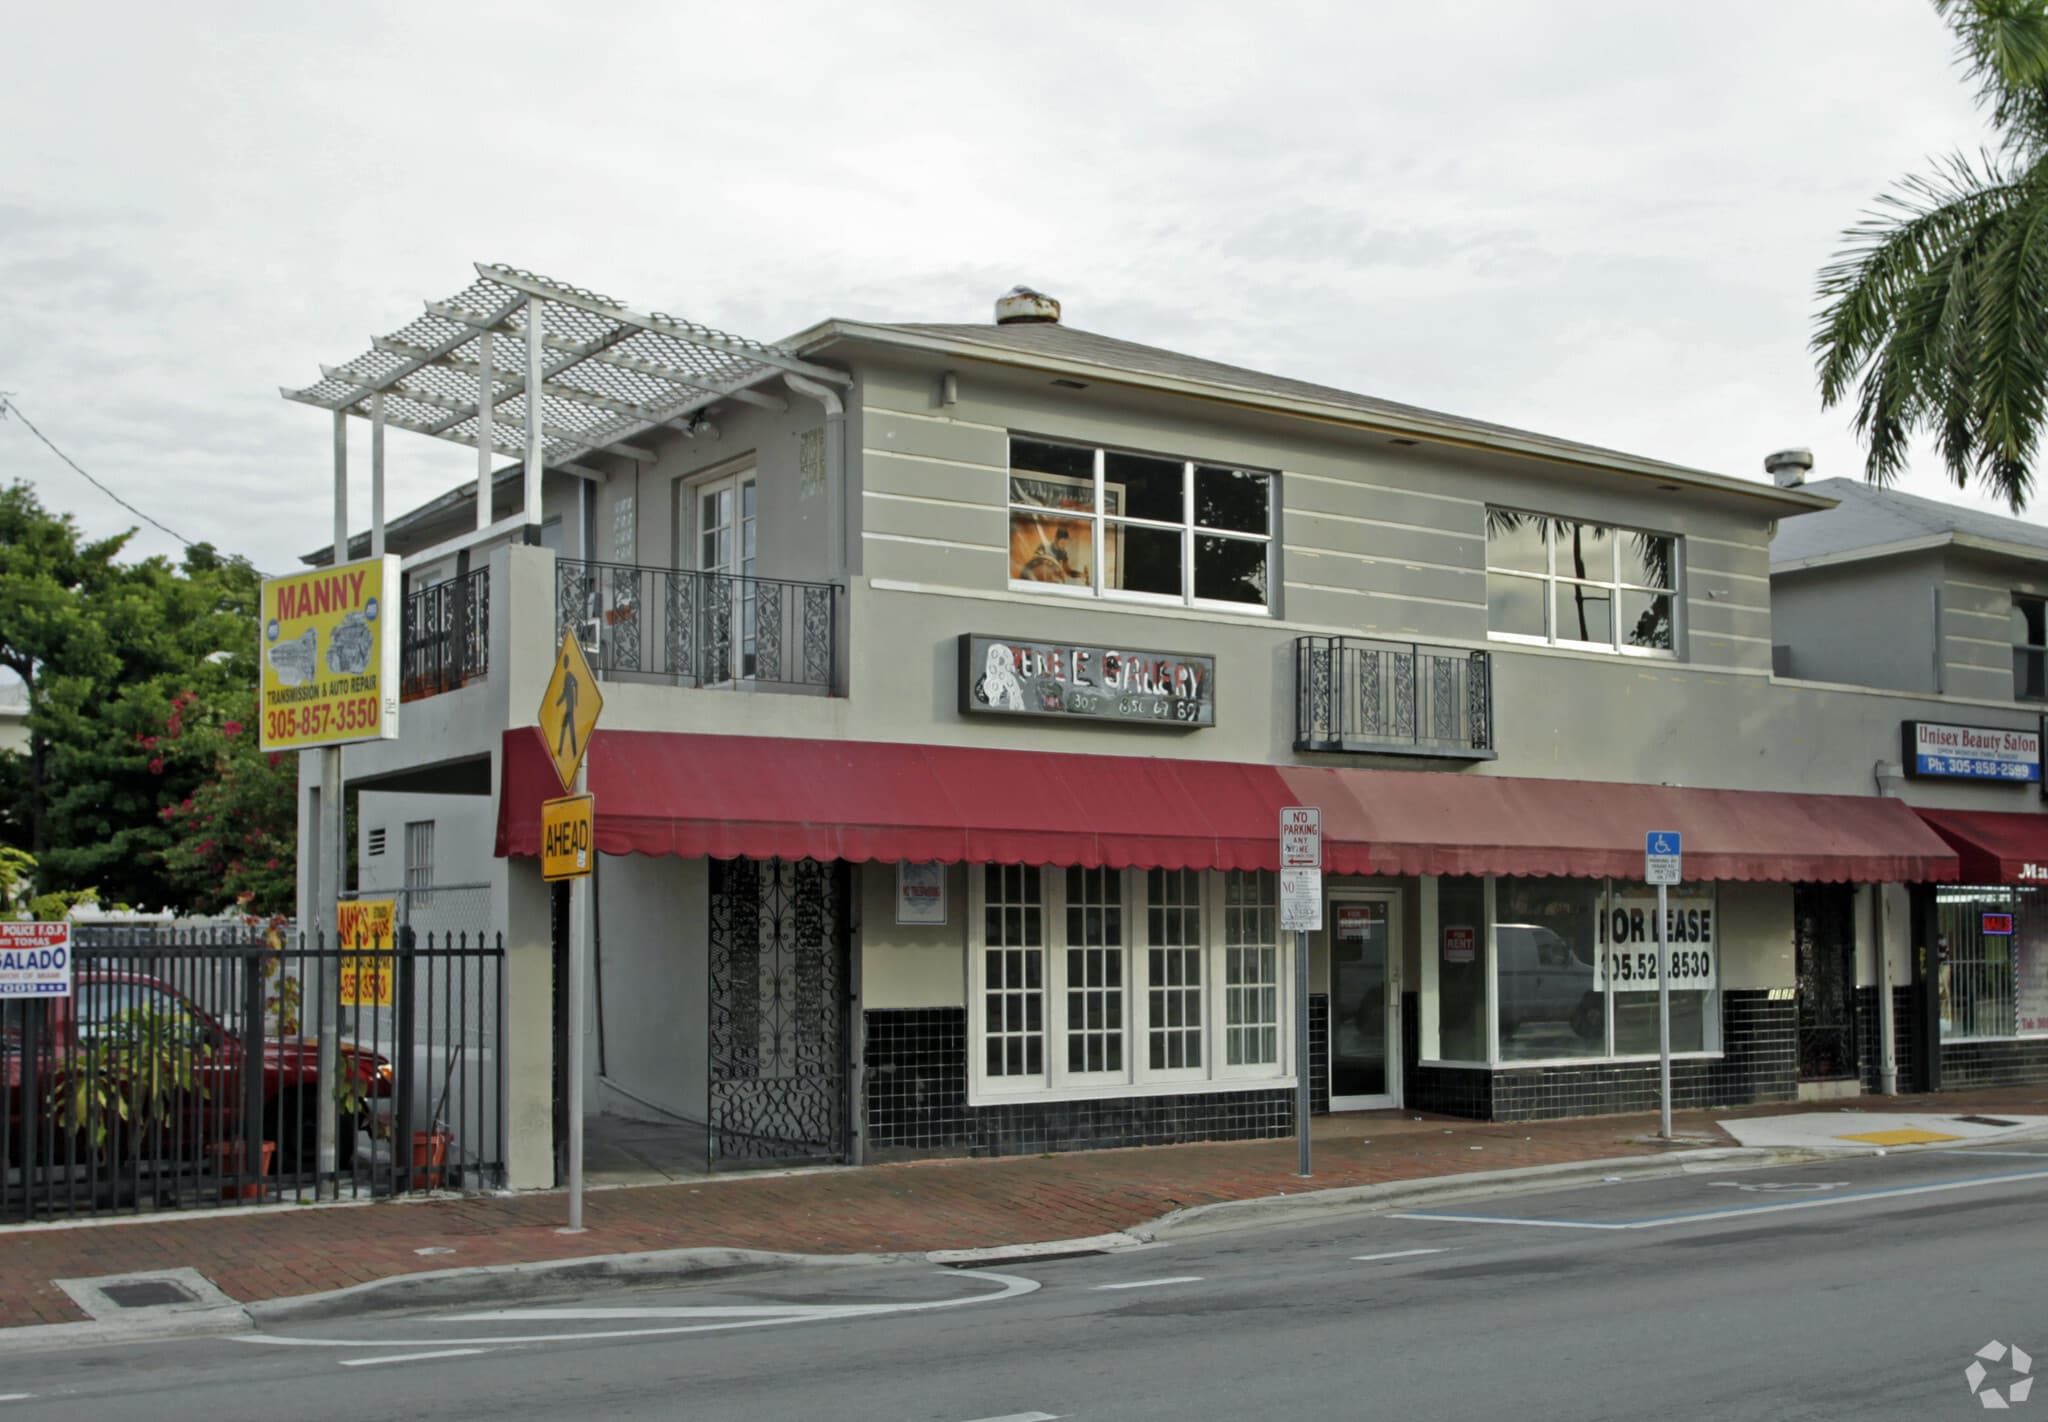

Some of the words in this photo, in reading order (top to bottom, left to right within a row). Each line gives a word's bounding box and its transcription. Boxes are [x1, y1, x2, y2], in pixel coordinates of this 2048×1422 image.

[277, 570, 366, 622] MANNY
[267, 684, 320, 706] TRANSMISSION
[322, 682, 328, 697] &
[329, 679, 350, 696] AUTO
[351, 674, 377, 693] REPAIR
[267, 696, 378, 740] 305-857-3550
[1919, 726, 1958, 747] Unisex
[1962, 729, 2001, 752] Beauty
[2003, 733, 2036, 753] Salon
[1928, 757, 1945, 771] Ph:
[1293, 811, 1308, 823] NO
[1283, 824, 1318, 836] PARKING
[545, 819, 588, 858] AHEAD
[3, 925, 35, 936] POLICE
[14, 936, 50, 947] TOMAS
[1447, 938, 1473, 950] RENT
